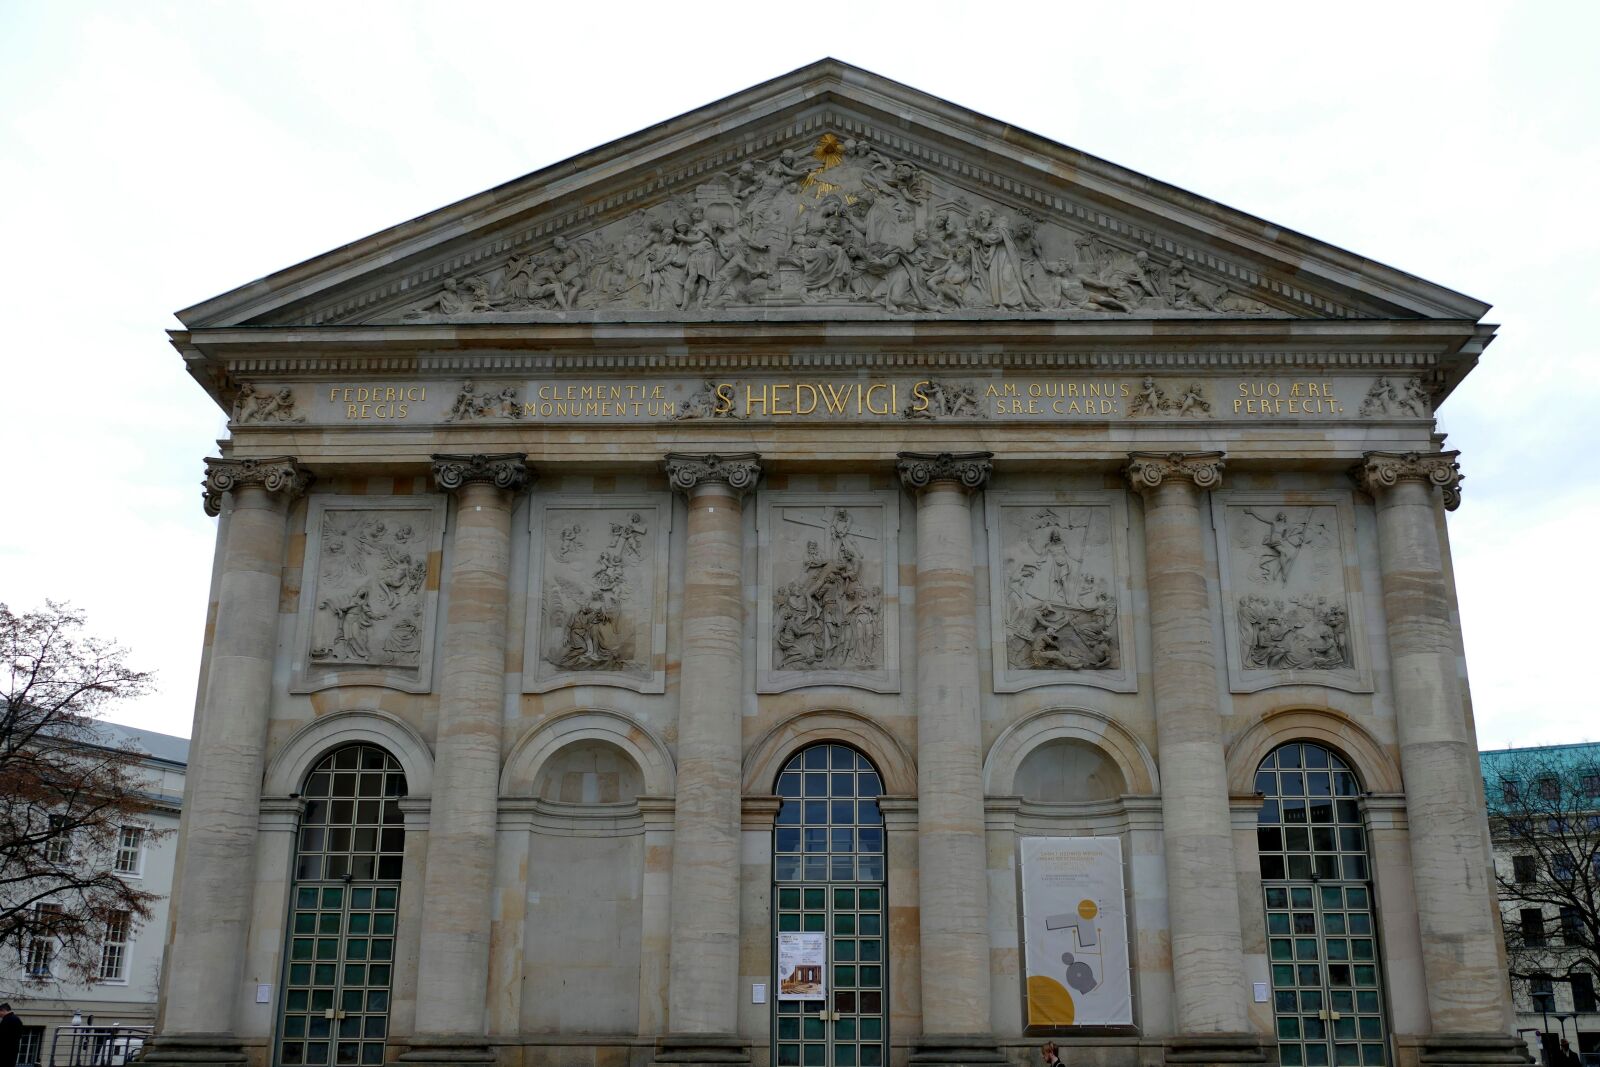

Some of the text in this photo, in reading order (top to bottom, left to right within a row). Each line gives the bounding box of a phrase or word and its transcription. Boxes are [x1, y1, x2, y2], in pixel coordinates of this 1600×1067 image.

[330, 387, 427, 402] FEDERICI
[539, 386, 666, 400] CLEMENTIÆ
[986, 384, 1130, 398] A.M. QUIRINUS
[1239, 383, 1334, 397] SUO ÆRE
[347, 404, 408, 419] REGIS
[524, 402, 675, 417] MONUMENTUM
[997, 400, 1044, 414] S.R.E.
[1233, 400, 1343, 414] PERFECIT.
